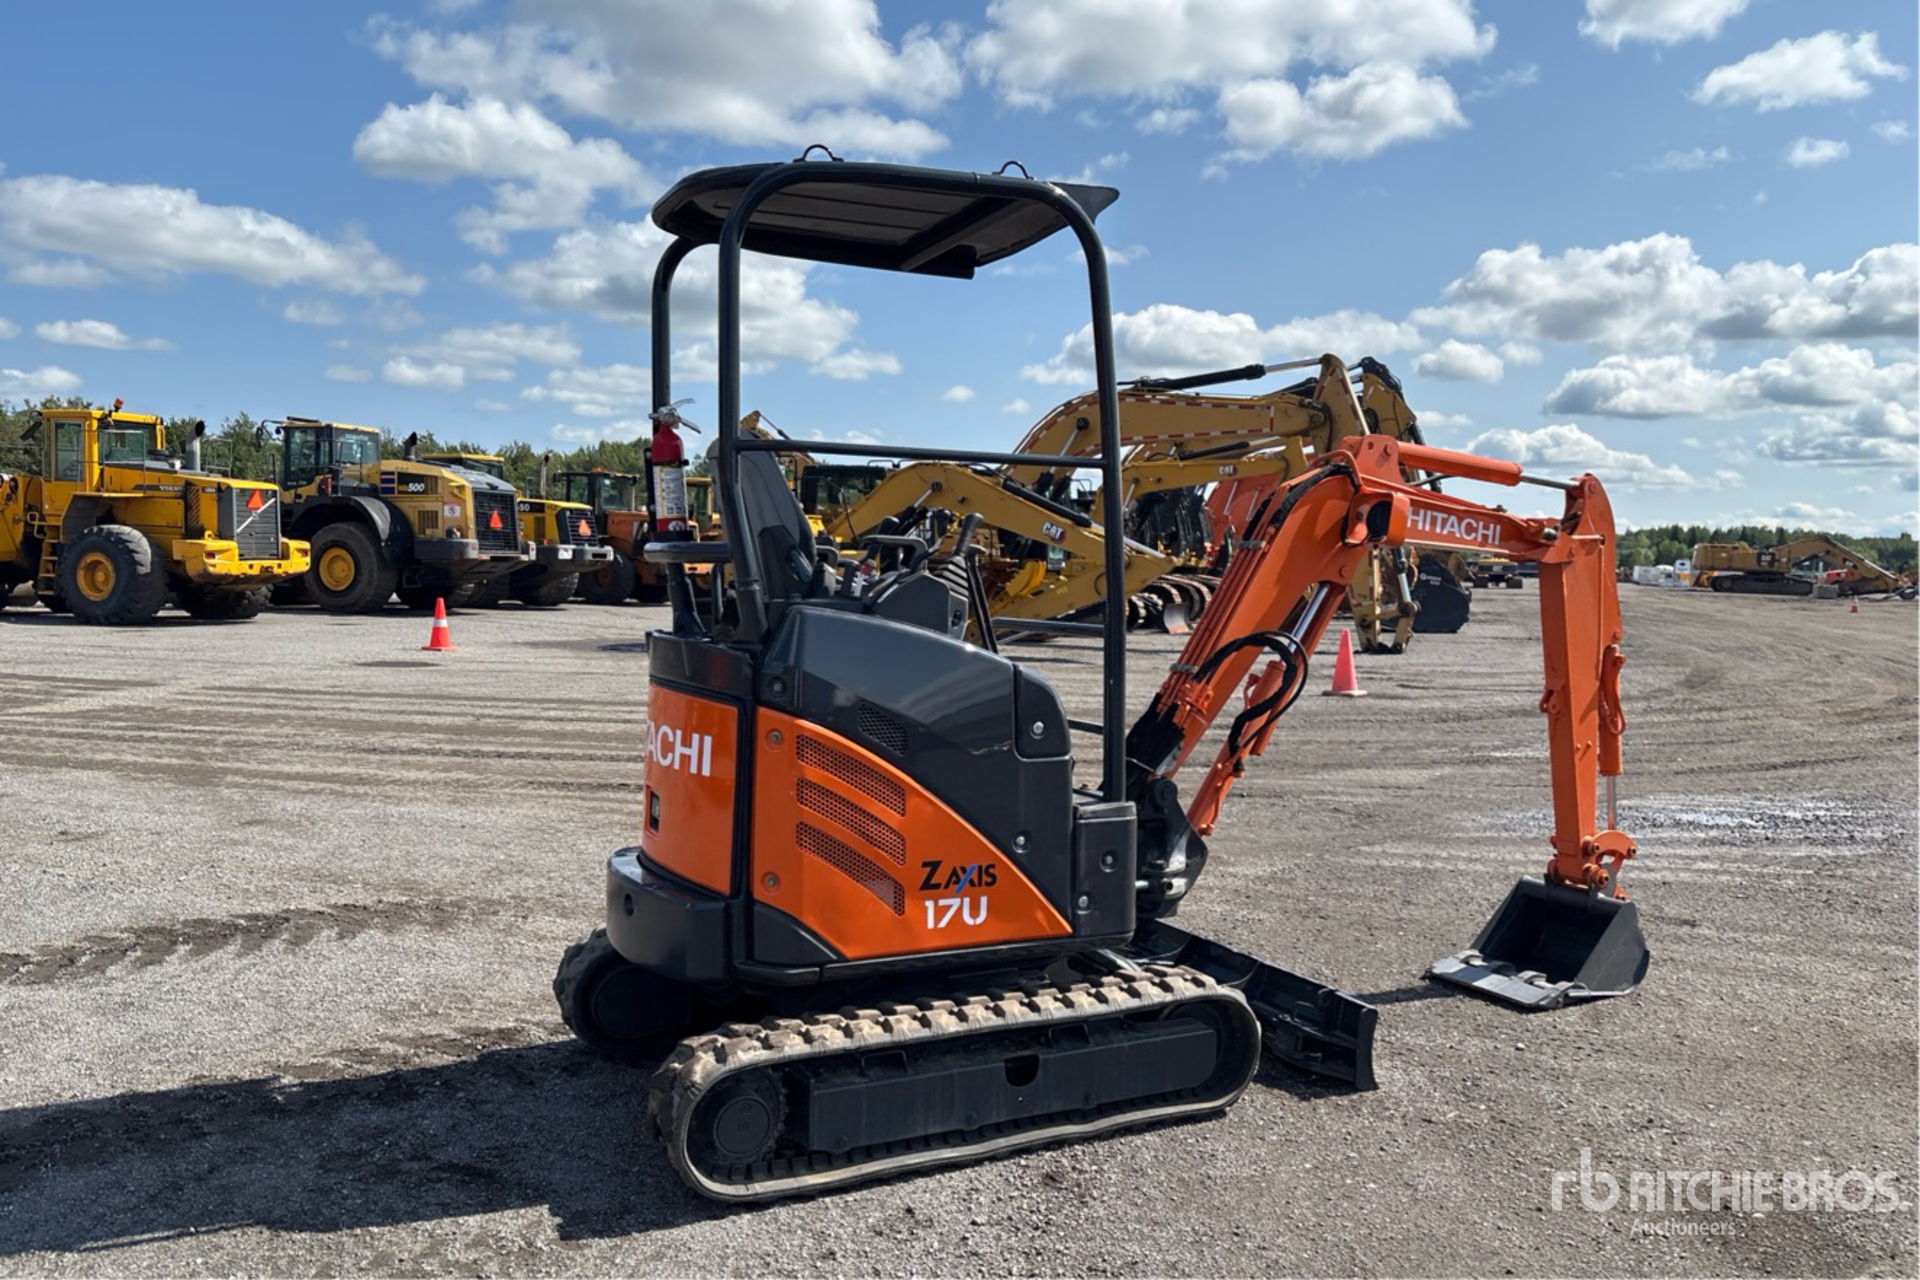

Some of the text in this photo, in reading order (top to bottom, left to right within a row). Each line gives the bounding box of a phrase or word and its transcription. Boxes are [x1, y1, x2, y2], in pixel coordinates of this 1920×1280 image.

[1042, 521, 1064, 540] CAT
[1406, 506, 1501, 546] HITACHI
[647, 720, 712, 777] ACHI
[918, 860, 998, 894] ZAXIS
[924, 895, 988, 930] 17U
